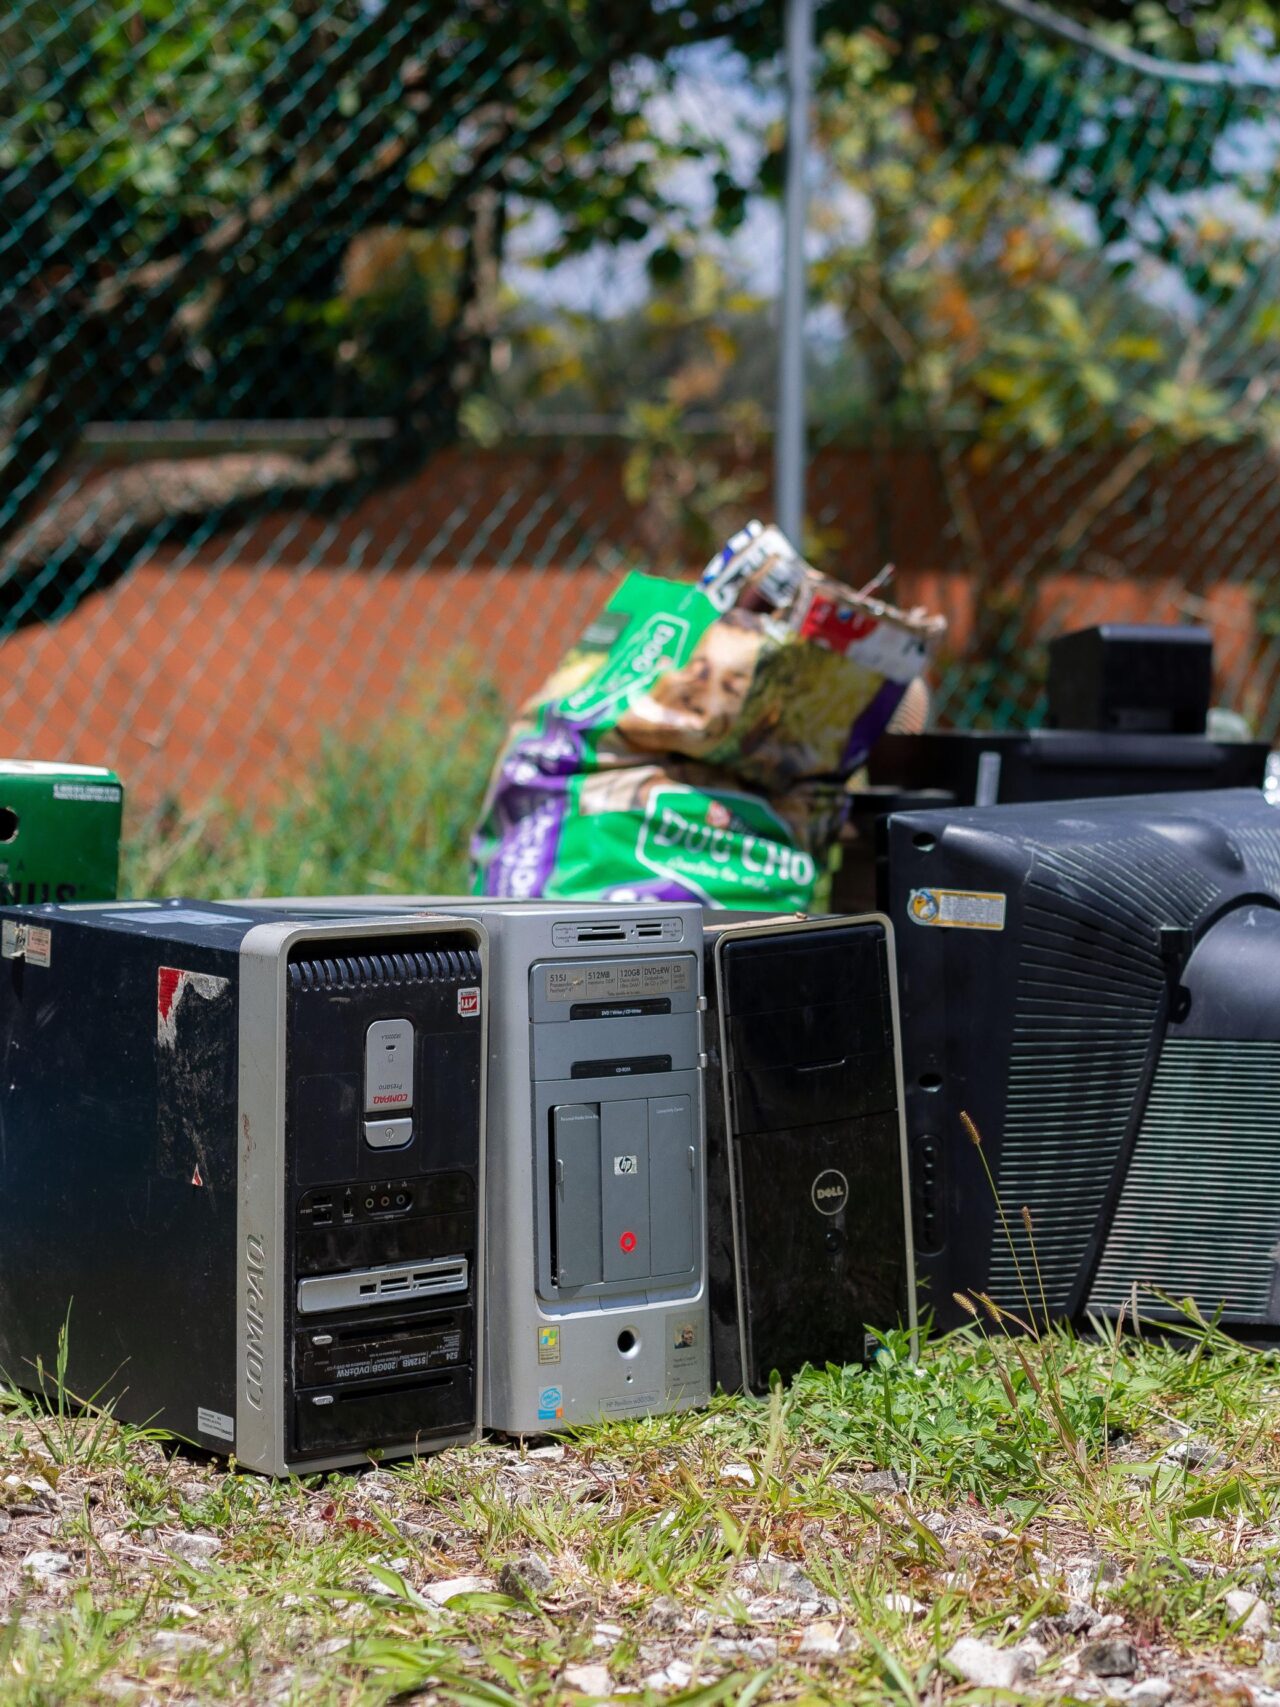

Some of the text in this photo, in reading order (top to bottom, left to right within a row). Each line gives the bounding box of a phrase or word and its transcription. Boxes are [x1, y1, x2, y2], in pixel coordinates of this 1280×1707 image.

[587, 971, 611, 980] 512MB
[620, 968, 641, 977] 120GB
[461, 997, 477, 1010] ATI
[378, 1083, 403, 1092] Presario
[373, 1093, 408, 1105] COMPAQ
[816, 1185, 844, 1200] DELL
[246, 1233, 265, 1411] COMPAQ
[446, 1351, 458, 1360] 524
[372, 1361, 396, 1372] 200GB
[402, 1356, 426, 1367] 512MB
[336, 1366, 371, 1378] DVD±RW
